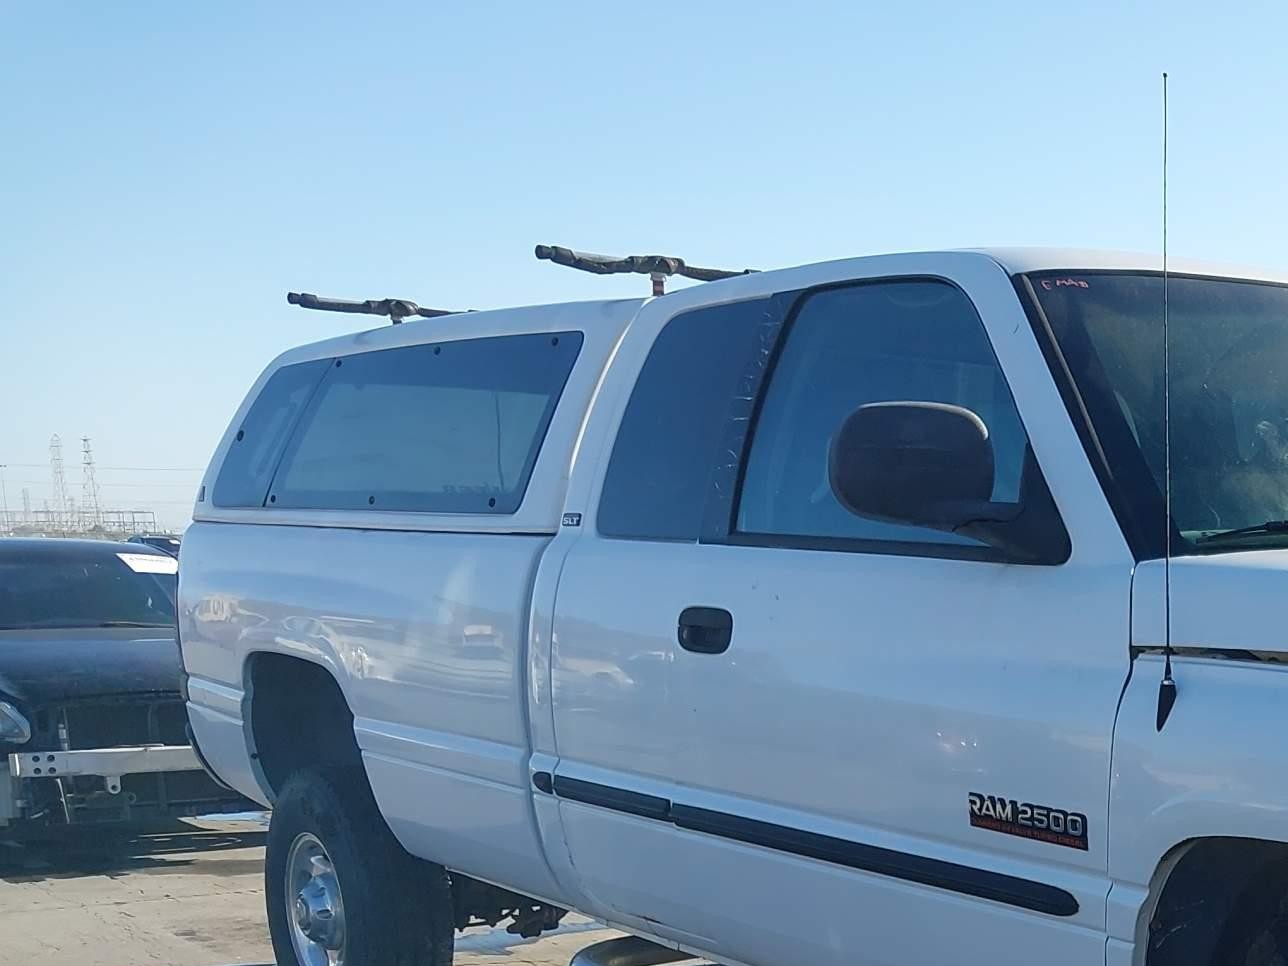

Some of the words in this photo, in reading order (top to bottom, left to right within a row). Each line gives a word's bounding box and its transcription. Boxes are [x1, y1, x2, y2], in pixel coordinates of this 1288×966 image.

[563, 517, 580, 525] SLT
[968, 792, 1015, 822] RAM
[1017, 803, 1085, 837] 2500
